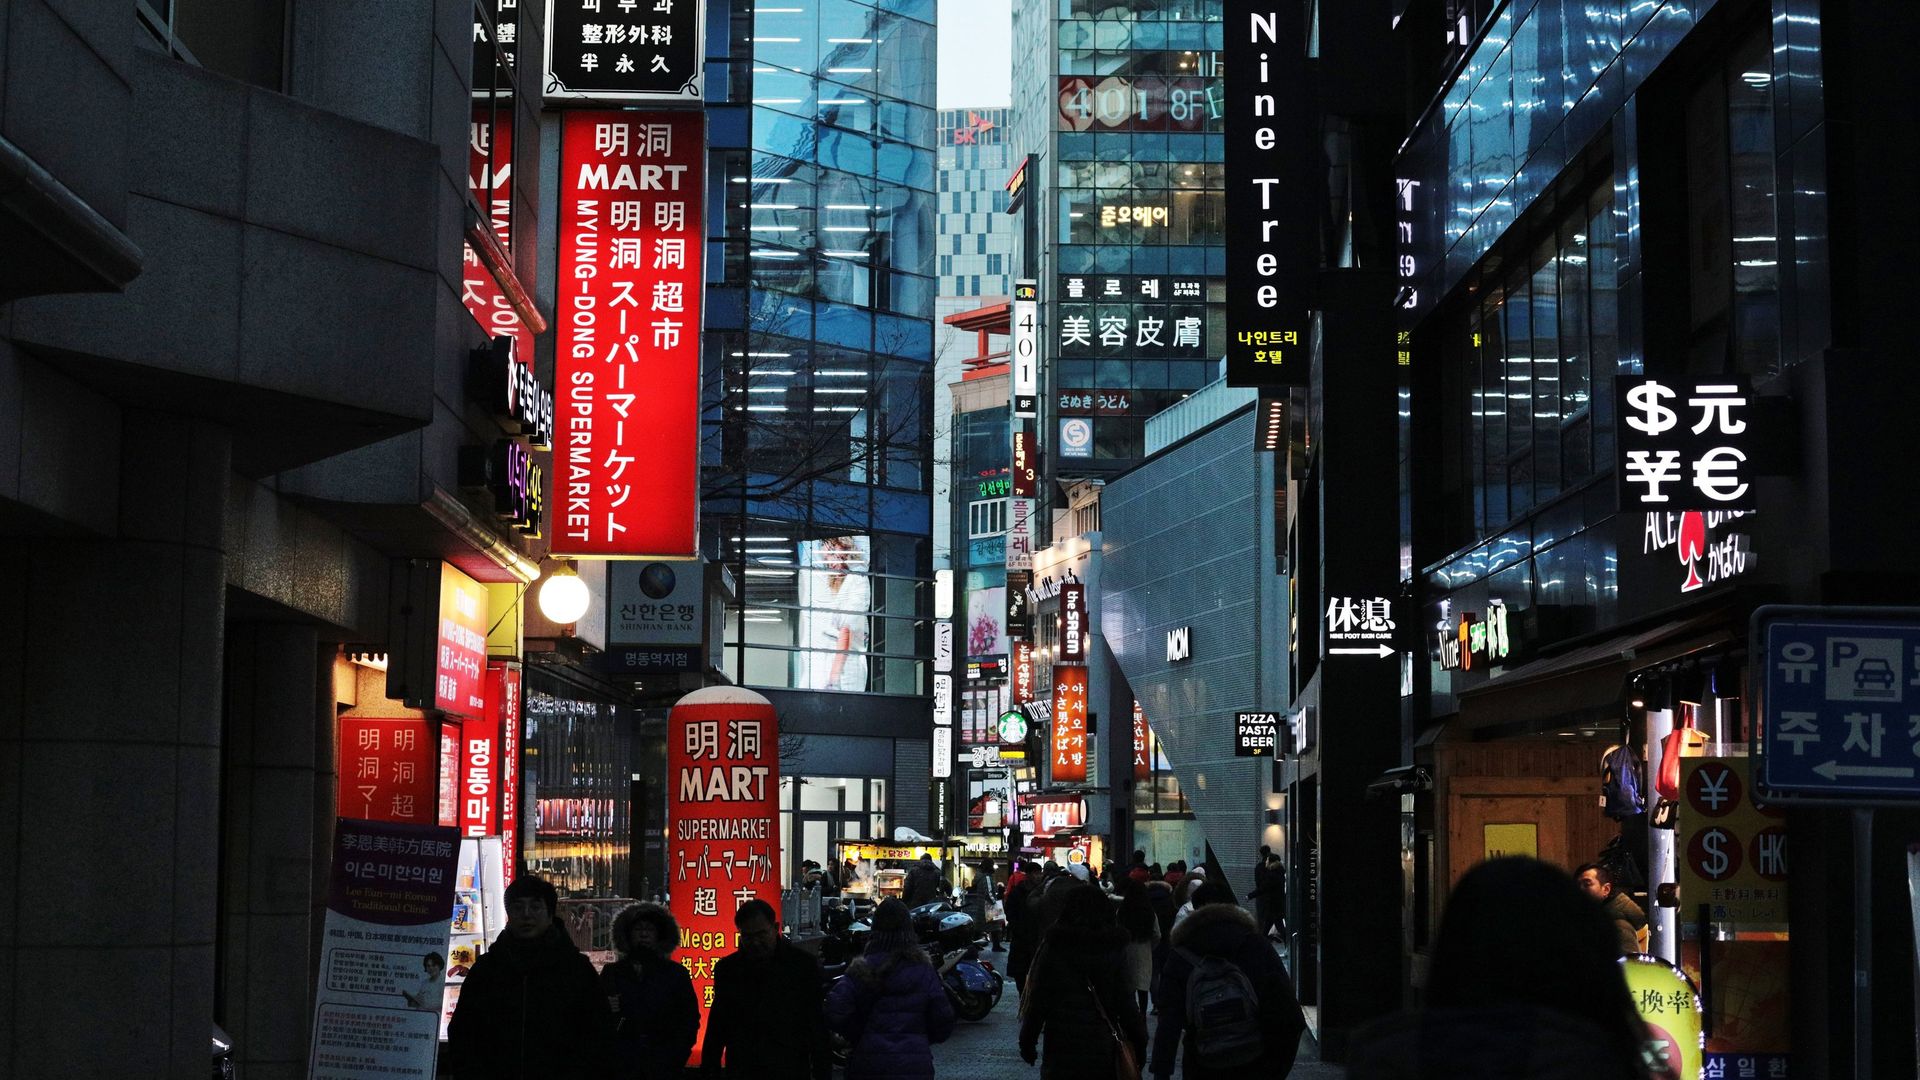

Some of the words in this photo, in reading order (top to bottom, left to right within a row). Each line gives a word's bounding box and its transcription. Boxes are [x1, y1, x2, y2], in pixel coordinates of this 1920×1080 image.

[581, 24, 673, 45] 整形外科
[580, 53, 671, 73] 半永久
[1250, 12, 1277, 150] Nine
[1065, 87, 1149, 120] 401
[1170, 89, 1203, 120] 8F
[594, 123, 673, 158] 明洞
[954, 128, 977, 145] SK
[576, 164, 688, 191] MART
[1101, 206, 1169, 228] 준오헤어
[1252, 178, 1280, 309] Tree
[571, 200, 599, 360] MYUNG-DONG
[650, 201, 687, 351] 明洞超市
[1067, 278, 1159, 299] 플로레
[1061, 315, 1202, 348] 美容皮膚
[1238, 331, 1299, 346] 나인트리
[1018, 313, 1034, 382] 401
[1254, 350, 1283, 365] 호텔
[602, 200, 642, 542] 明洞スーパーマーケット
[1020, 400, 1032, 408] 8F
[1060, 395, 1093, 409] さぬき
[1098, 395, 1130, 409] うどん
[1625, 380, 1678, 436] $
[1688, 385, 1747, 435] 元
[567, 370, 596, 542] SUPERMARKET
[1026, 468, 1035, 481] 3
[1625, 450, 1682, 502] ¥
[1692, 446, 1749, 501] €
[1012, 500, 1030, 554] 플로레
[620, 604, 694, 622] 신한은행
[1066, 591, 1080, 611] the
[1325, 596, 1396, 632] 休息
[1167, 626, 1190, 662] MCM
[1832, 642, 1859, 668] P
[625, 651, 688, 668] 명동역지점
[1056, 683, 1070, 765] やさ男かばん
[1071, 682, 1085, 765] 야사오가방
[1239, 714, 1276, 724] PIZZA
[1239, 726, 1277, 735] PASTA
[684, 720, 762, 760] 明洞
[1242, 737, 1274, 747] BEER
[680, 767, 770, 802] MART
[677, 818, 771, 841] SUPERMARKET
[344, 861, 443, 885] 이은미한의원
[678, 846, 772, 884] スーパーマーケット
[680, 928, 725, 951] Mega
